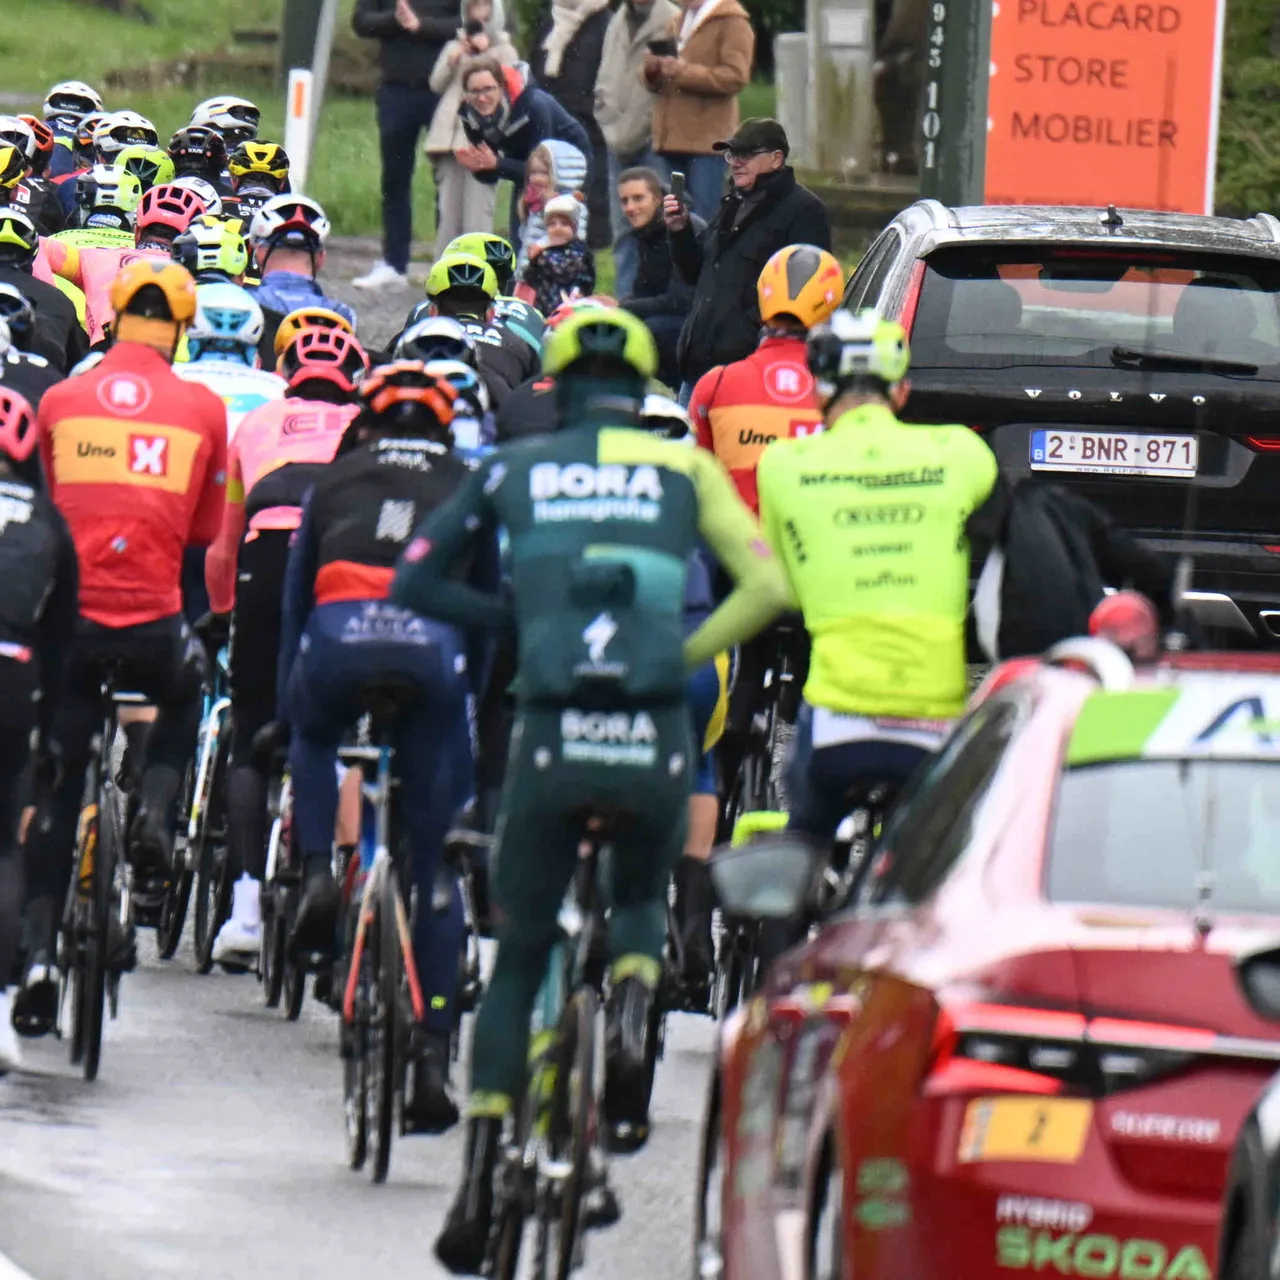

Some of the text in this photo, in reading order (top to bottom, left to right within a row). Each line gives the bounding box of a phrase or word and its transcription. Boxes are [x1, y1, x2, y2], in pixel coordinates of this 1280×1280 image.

[1014, 55, 1128, 89] STORE
[922, 81, 941, 168] 101
[1010, 112, 1177, 148] MOBILIER
[460, 324, 502, 339] RA
[1025, 388, 1208, 406] VOLVO
[76, 436, 166, 477] Uno X
[1033, 449, 1044, 460] B
[1048, 435, 1191, 465] 2-BNR-871
[530, 462, 664, 500] BORA
